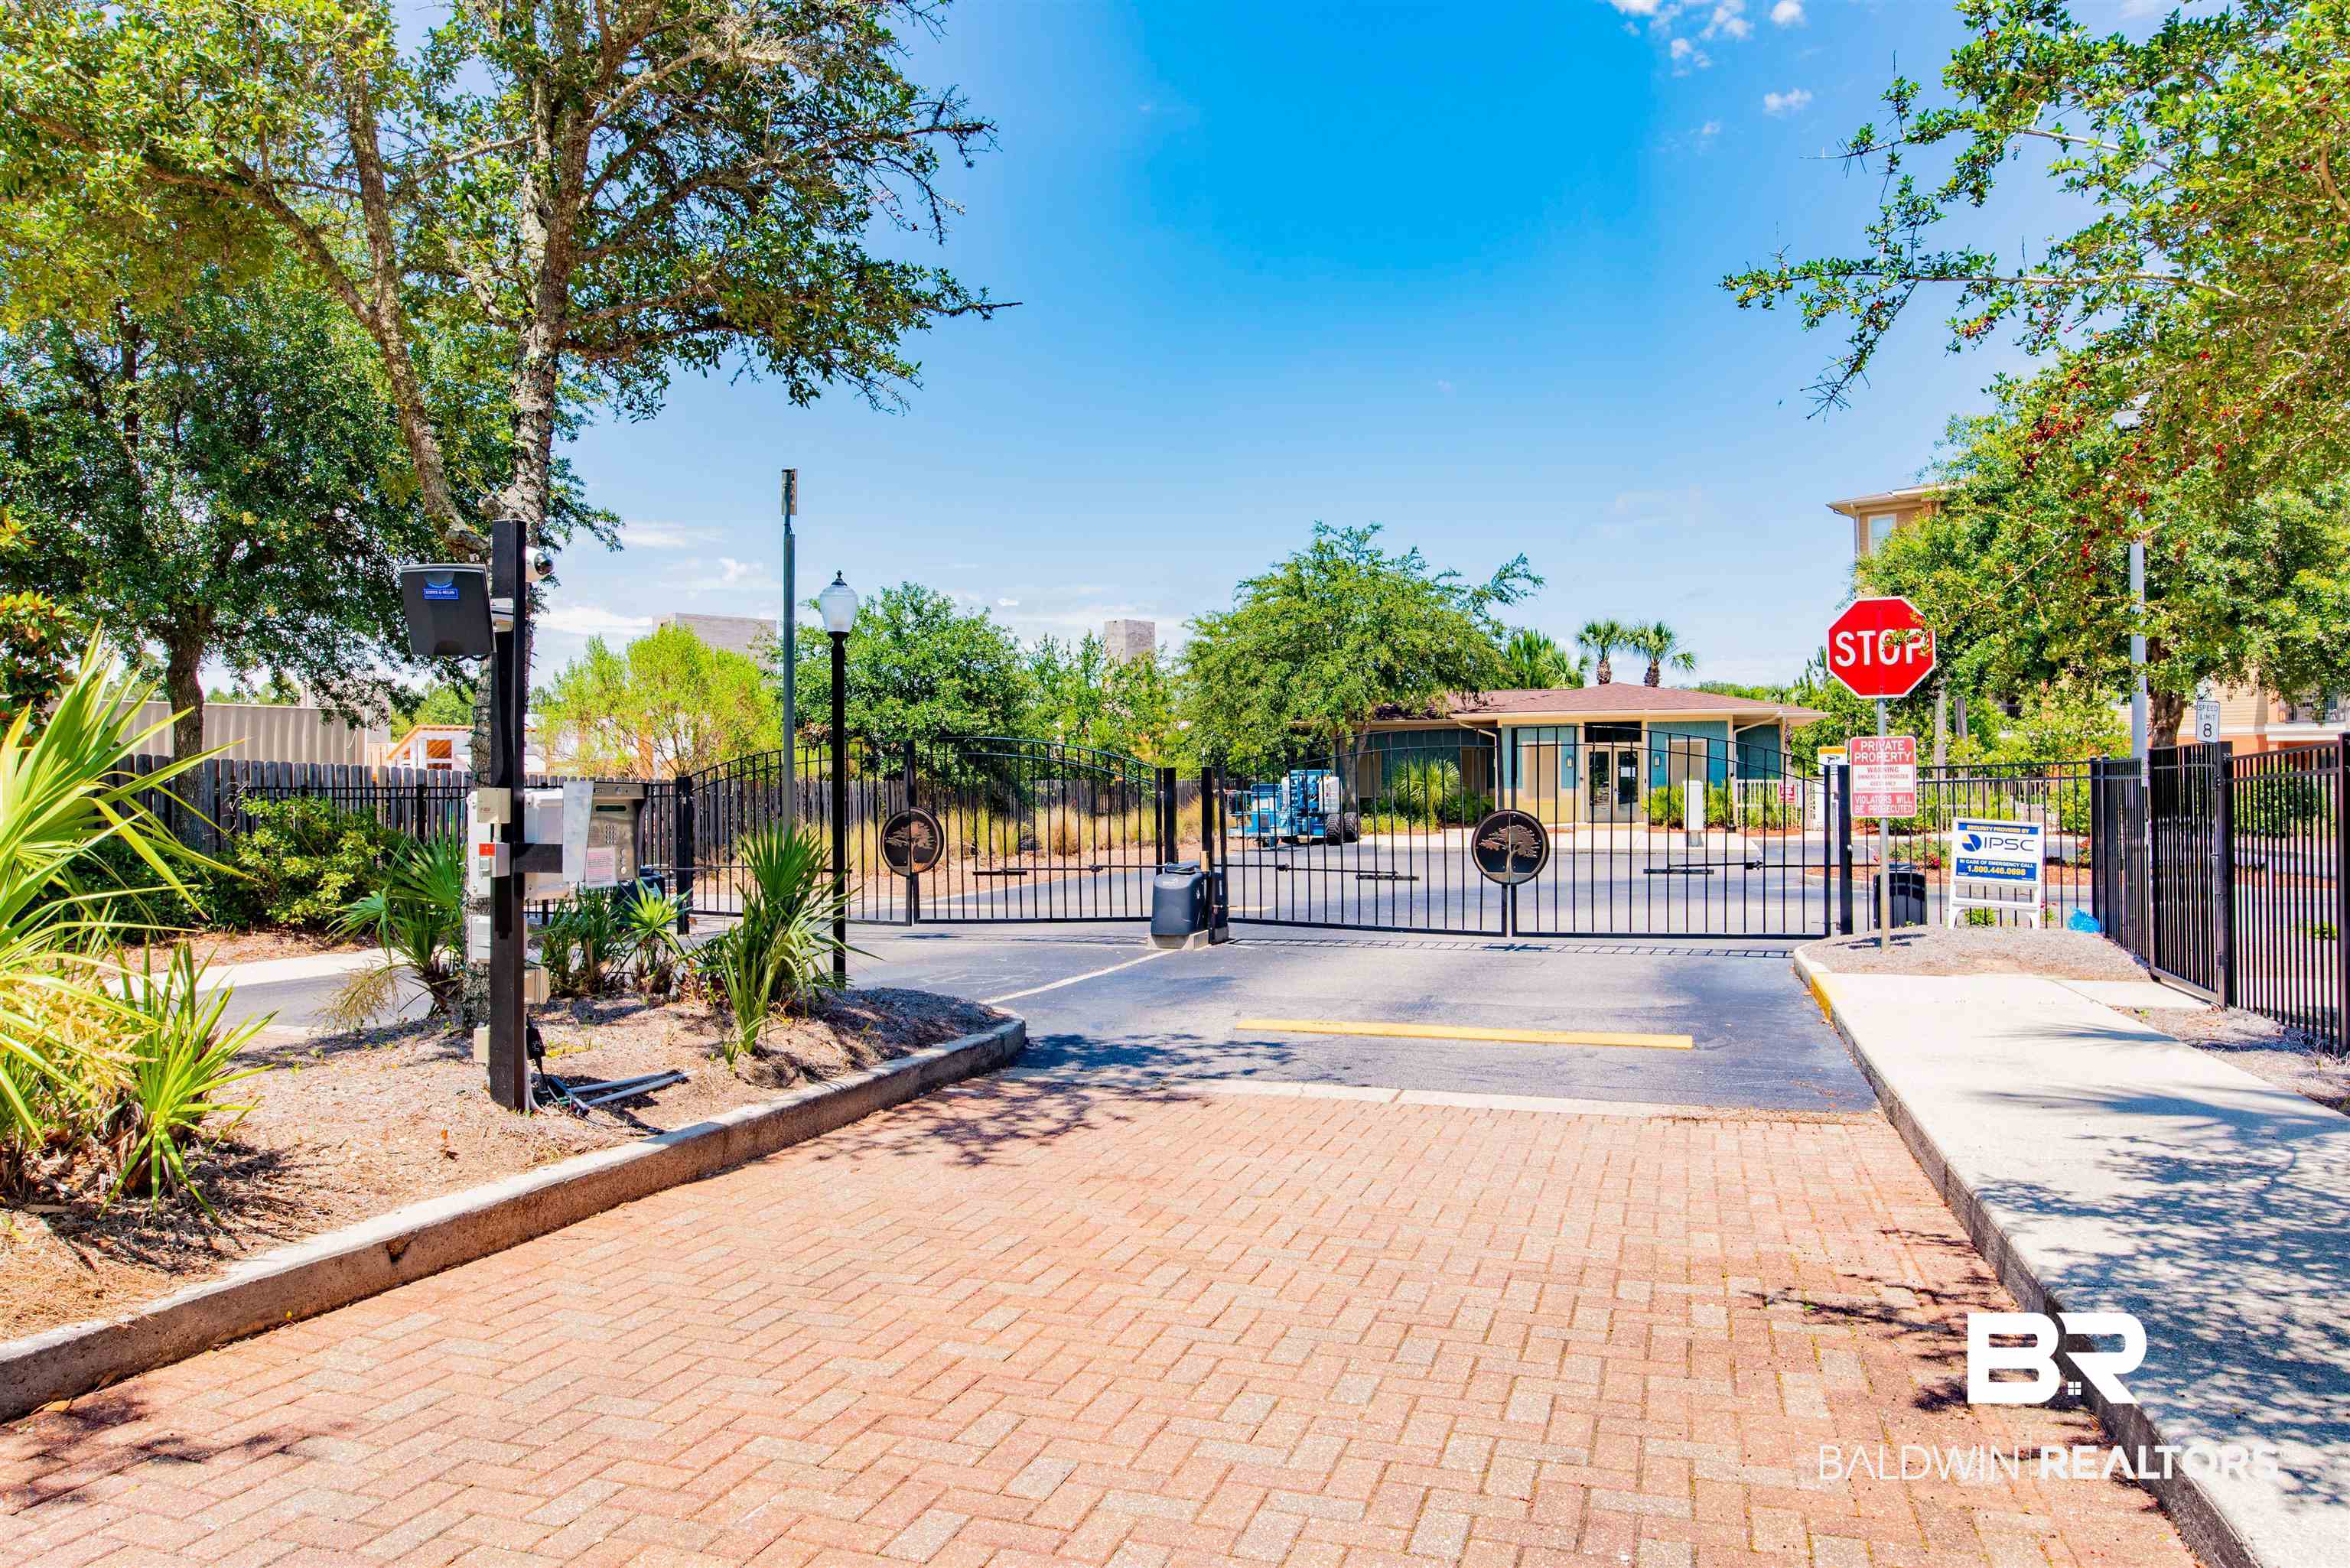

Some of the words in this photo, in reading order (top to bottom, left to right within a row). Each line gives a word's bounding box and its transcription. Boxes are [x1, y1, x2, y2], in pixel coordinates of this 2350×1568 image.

[1834, 627, 1928, 667] STOP
[2203, 723, 2212, 738] 8
[1860, 740, 1905, 751] PRIVATE
[1854, 752, 1911, 763] PROPERTY
[1855, 795, 1892, 804] VIOLATORS
[1896, 795, 1912, 804] WILL
[1854, 805, 1865, 813] BE
[1868, 804, 1912, 814] PROSECUTED
[1984, 837, 2035, 851] IPSC
